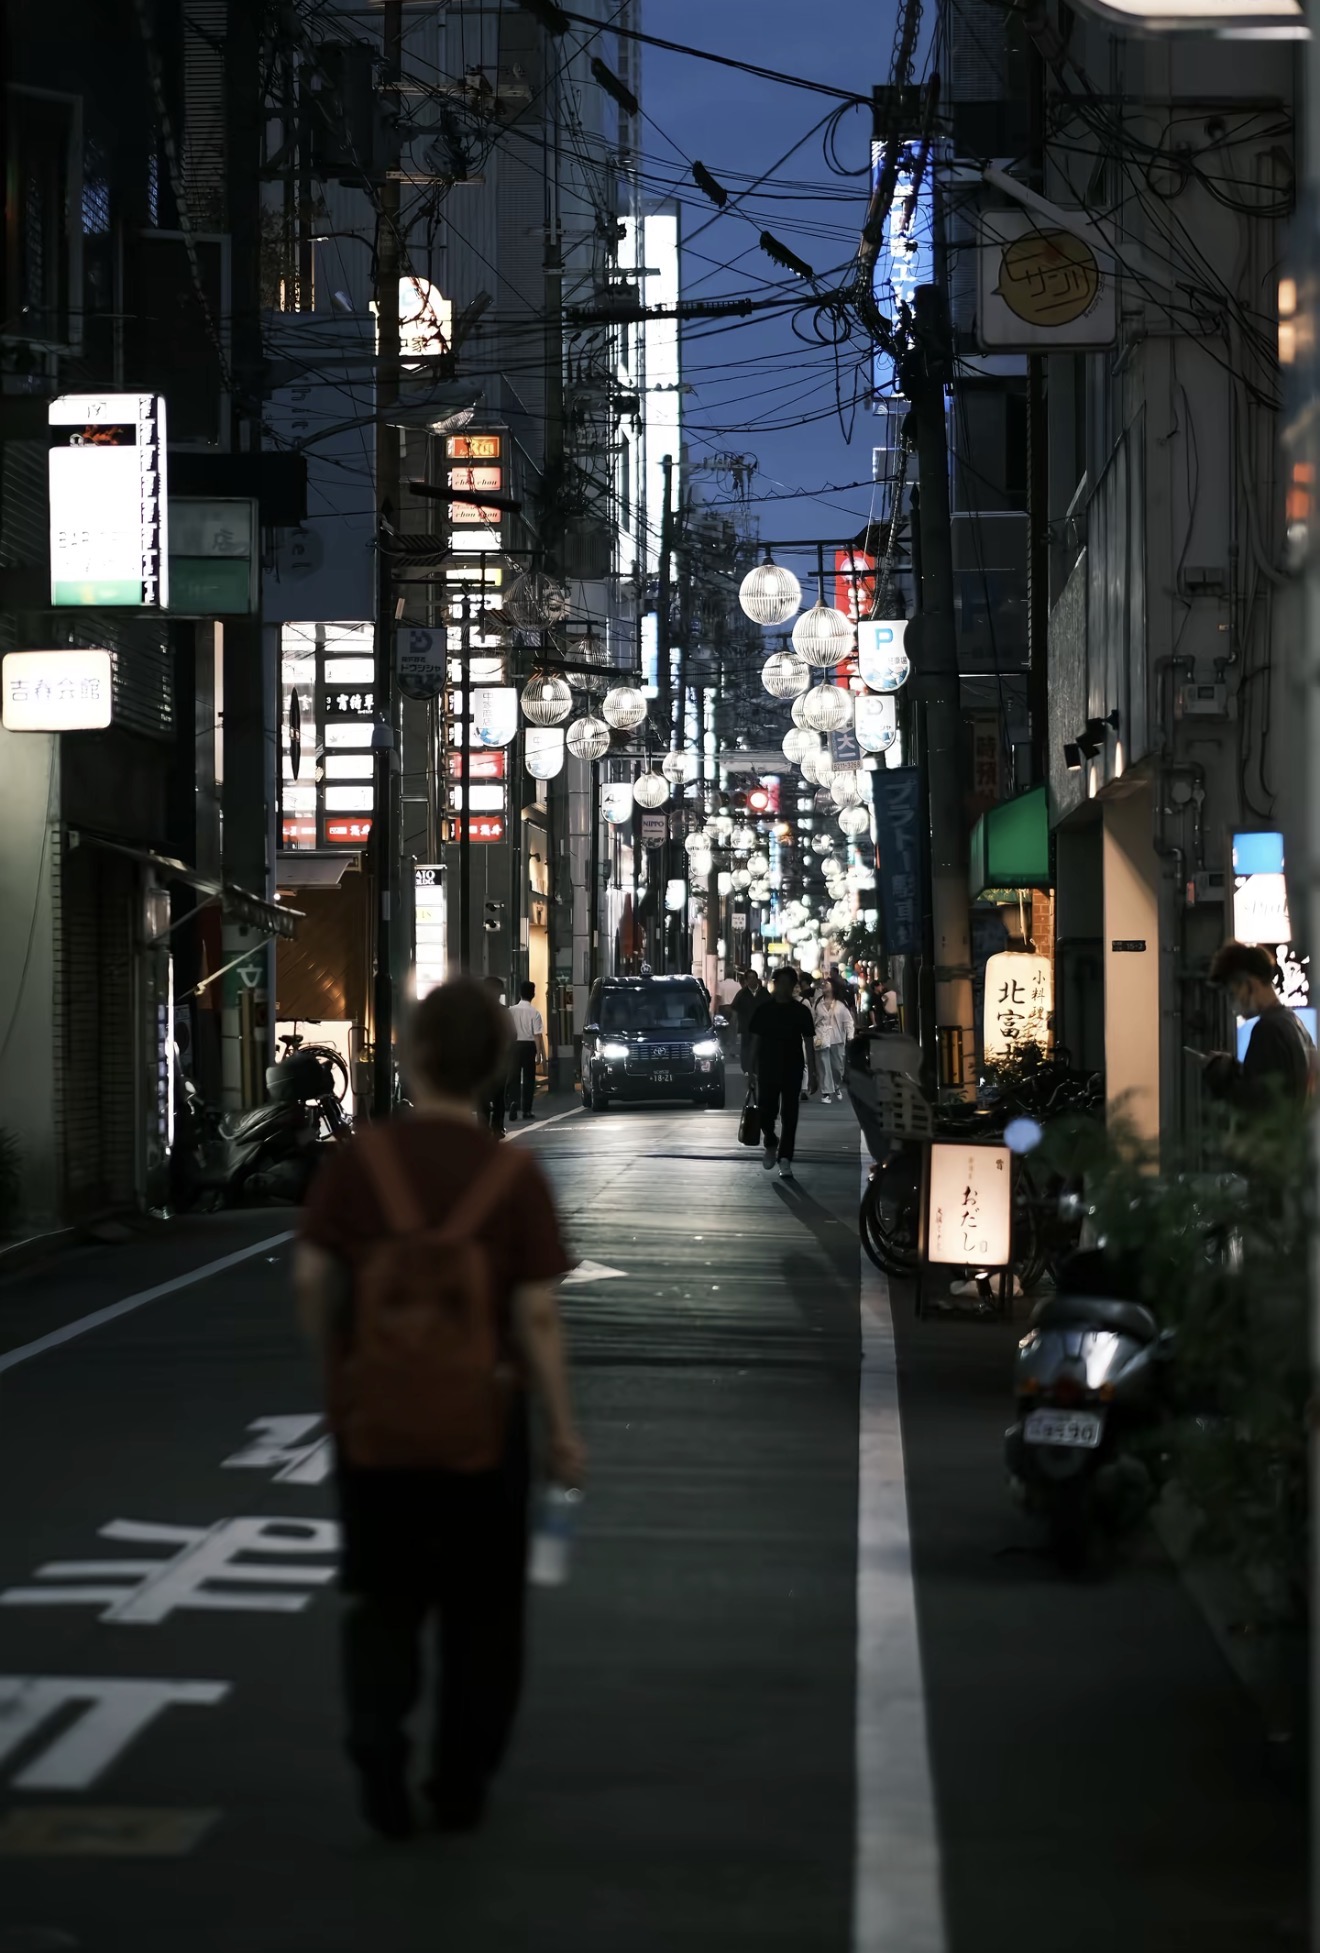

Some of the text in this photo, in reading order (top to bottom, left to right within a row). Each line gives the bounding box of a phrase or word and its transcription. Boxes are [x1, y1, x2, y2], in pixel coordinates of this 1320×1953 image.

[874, 627, 894, 650] P
[401, 664, 441, 672] ドウシシャ
[960, 1185, 980, 1252] おだし
